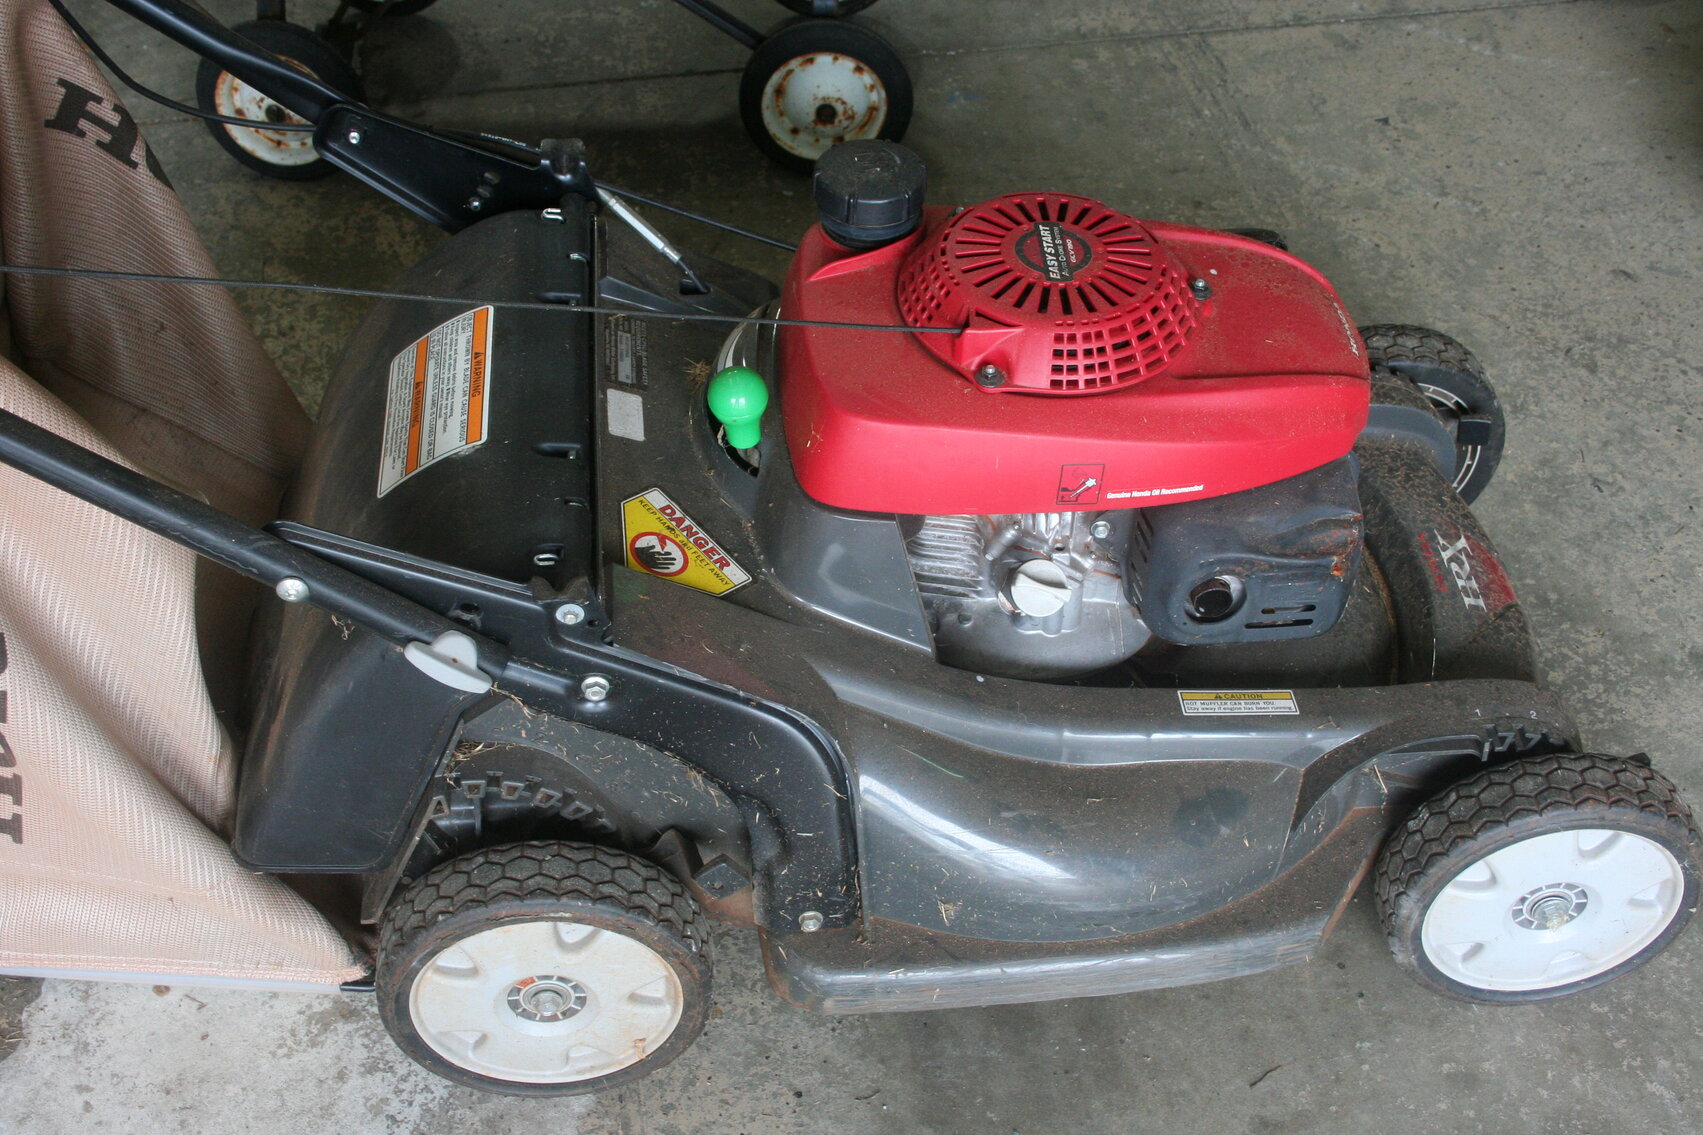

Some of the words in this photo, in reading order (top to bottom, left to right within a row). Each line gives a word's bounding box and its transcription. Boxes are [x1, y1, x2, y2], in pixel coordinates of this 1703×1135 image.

[1039, 225, 1055, 254] START
[1046, 254, 1060, 279] EASY
[471, 358, 481, 397] WARNING
[412, 387, 424, 428] WARNING
[1160, 484, 1204, 495] Recommended
[638, 499, 657, 516] KEEP
[656, 516, 680, 539] HANDS
[679, 539, 691, 551] and
[691, 550, 710, 567] FEET
[708, 565, 730, 586] AWAY
[659, 504, 731, 571] DANGER
[1434, 529, 1487, 613] HRX
[1475, 708, 1482, 717] 1
[1529, 710, 1538, 720] 2
